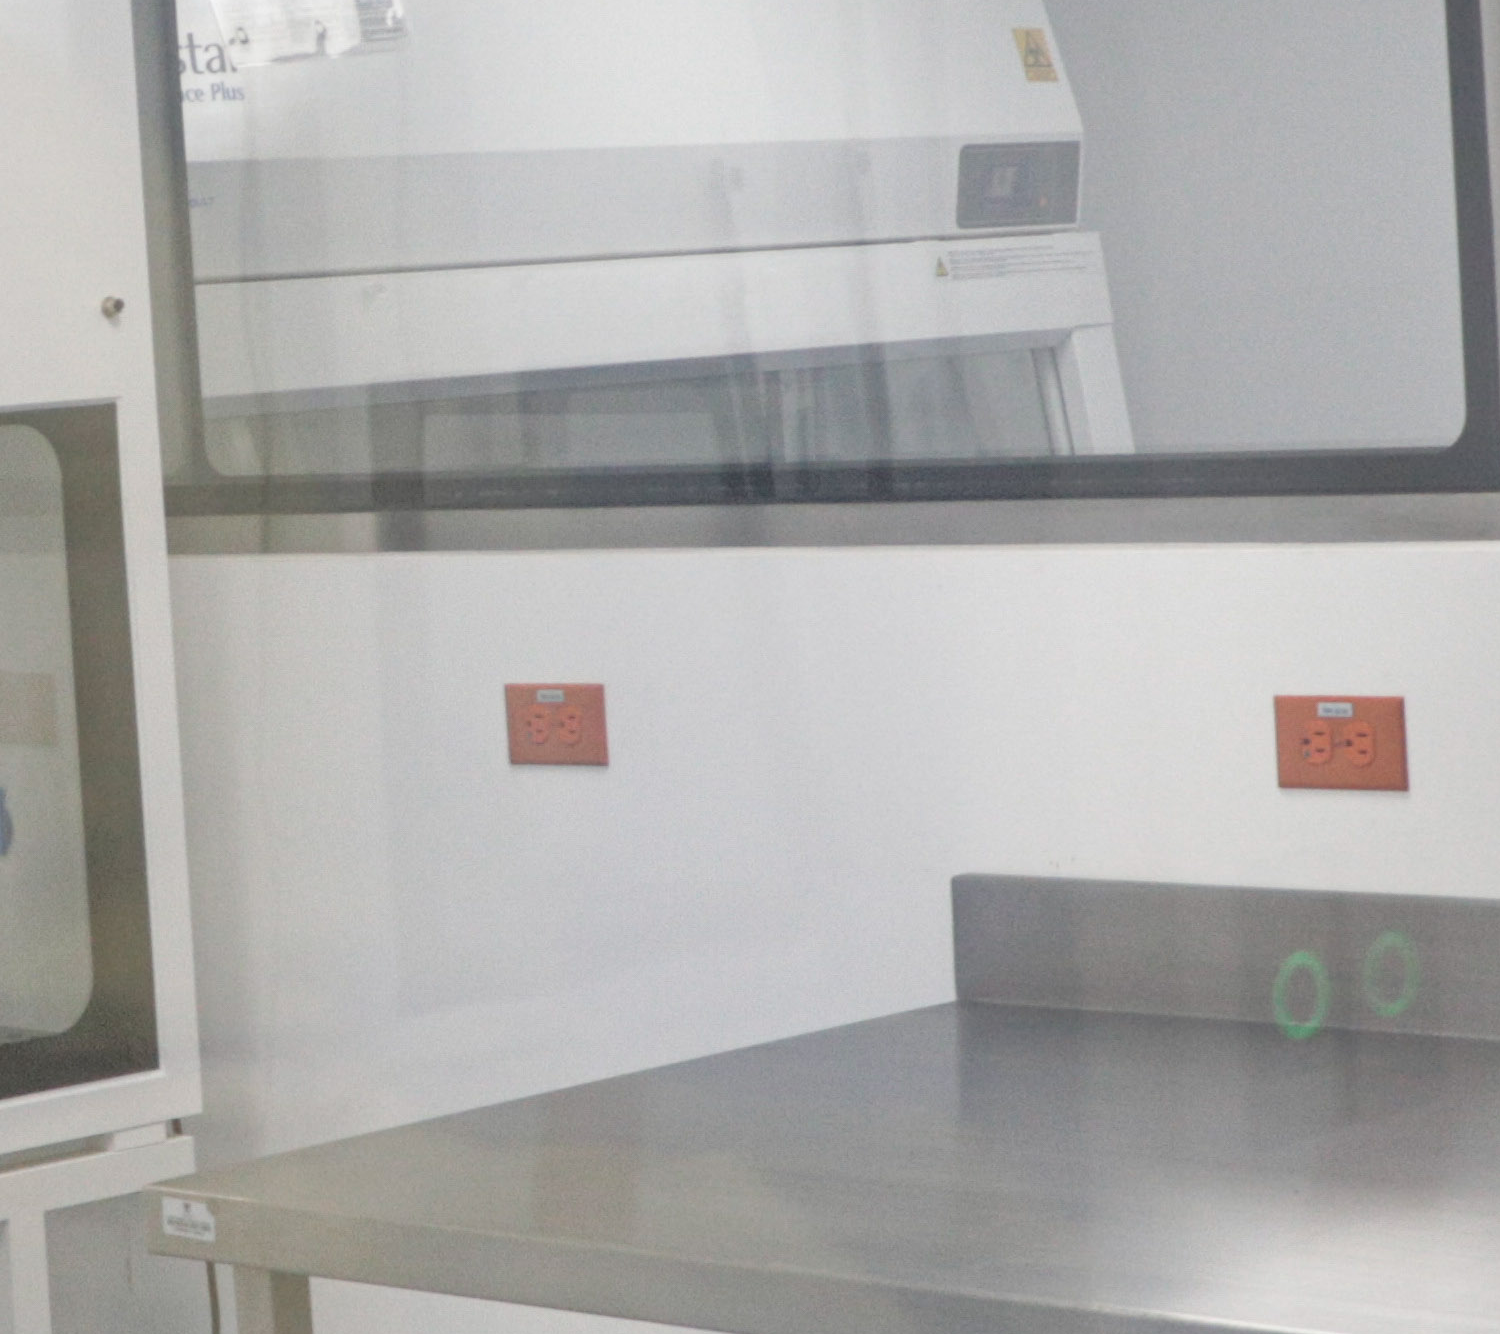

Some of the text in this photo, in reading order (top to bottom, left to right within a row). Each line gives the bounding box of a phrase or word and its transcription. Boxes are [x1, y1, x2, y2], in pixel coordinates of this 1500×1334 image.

[179, 32, 238, 74] sta
[180, 81, 245, 103] ce Plus
